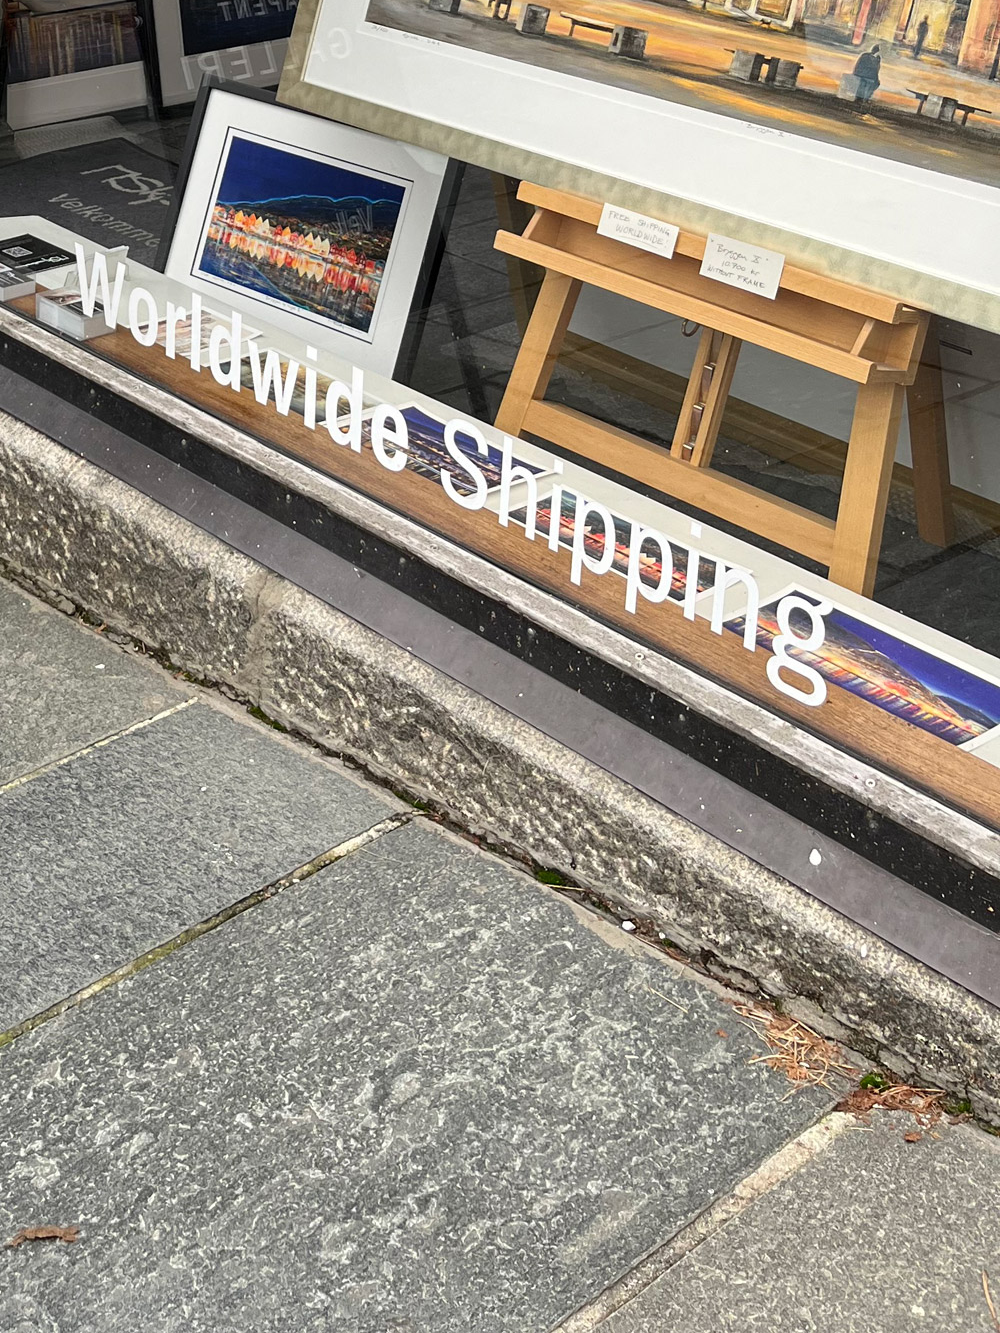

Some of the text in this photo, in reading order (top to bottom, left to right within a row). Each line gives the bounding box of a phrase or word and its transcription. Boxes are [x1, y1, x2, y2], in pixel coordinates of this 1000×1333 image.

[609, 210, 670, 236] FREE SHIPPING
[74, 242, 834, 707] Worldwide Shipping
